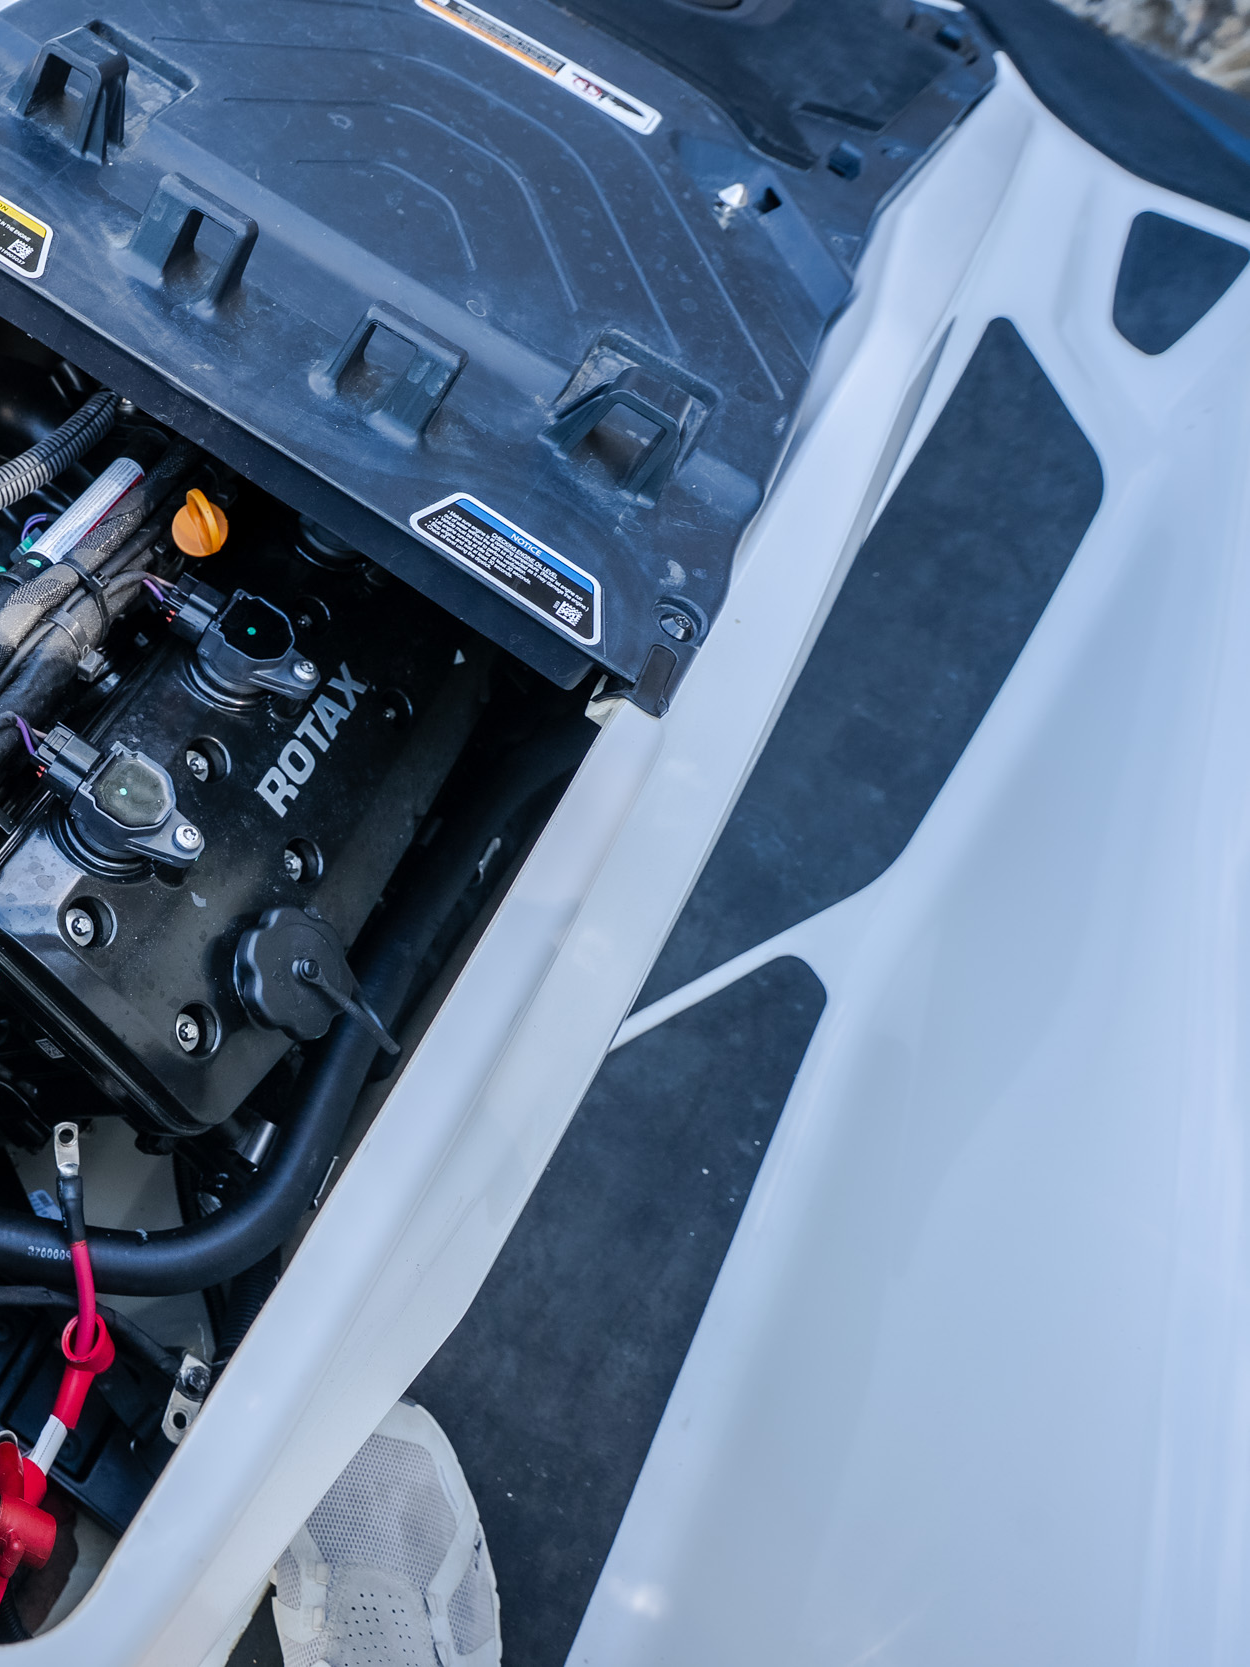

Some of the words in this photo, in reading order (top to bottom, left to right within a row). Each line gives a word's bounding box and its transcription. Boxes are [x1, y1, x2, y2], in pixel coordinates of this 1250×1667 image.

[4, 223, 15, 231] THE
[13, 229, 31, 242] ENGINE
[490, 532, 517, 552] CHECKING
[515, 548, 535, 564] ENGINE
[533, 560, 543, 569] OIL
[541, 566, 558, 580] LEVEL
[510, 533, 542, 556] NOTICE
[255, 661, 368, 818] ROTAX
